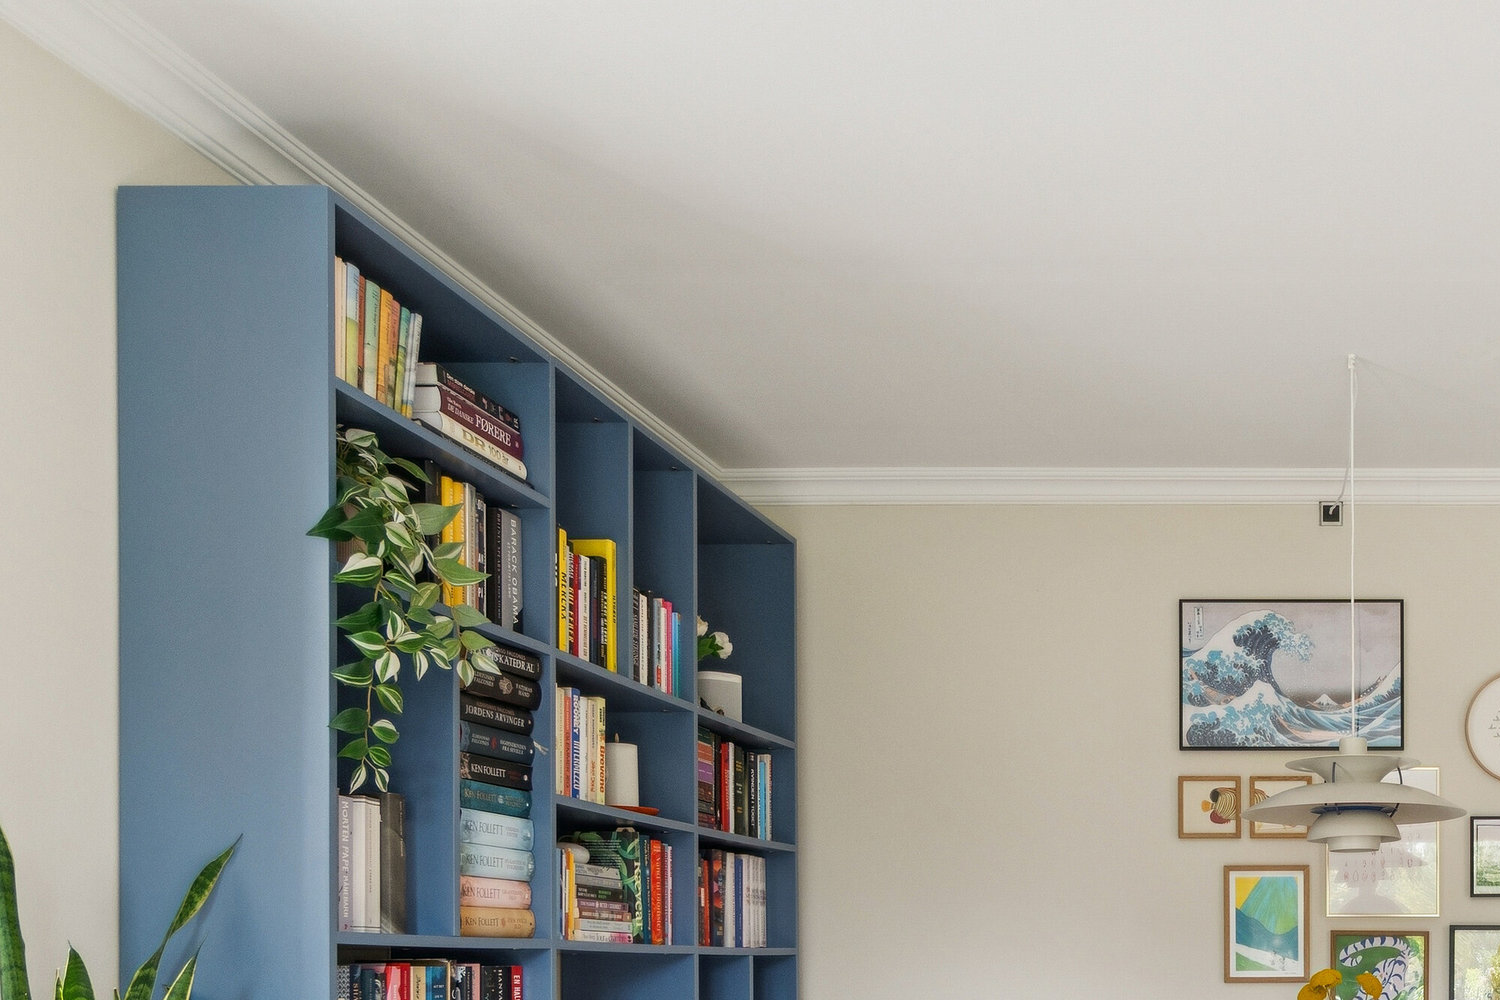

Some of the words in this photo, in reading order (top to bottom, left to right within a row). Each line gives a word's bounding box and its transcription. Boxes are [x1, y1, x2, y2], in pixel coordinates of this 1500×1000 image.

[475, 414, 512, 447] FØRERE
[510, 519, 518, 573] BARACK
[465, 704, 494, 720] JORDENS
[494, 712, 525, 727] ARVINGER
[471, 763, 483, 774] KEN
[483, 765, 506, 778] FOLLETT
[341, 801, 349, 842] MORTEN
[465, 820, 478, 832] KEN
[479, 821, 504, 835] FOLLETT
[466, 854, 479, 865] KEN
[480, 855, 504, 868] FOLLETT
[463, 885, 475, 896] KEN
[476, 886, 500, 899] FOLLETT
[465, 917, 476, 926] KEN
[478, 917, 498, 927] FOLLETT
[513, 975, 520, 985] EN
